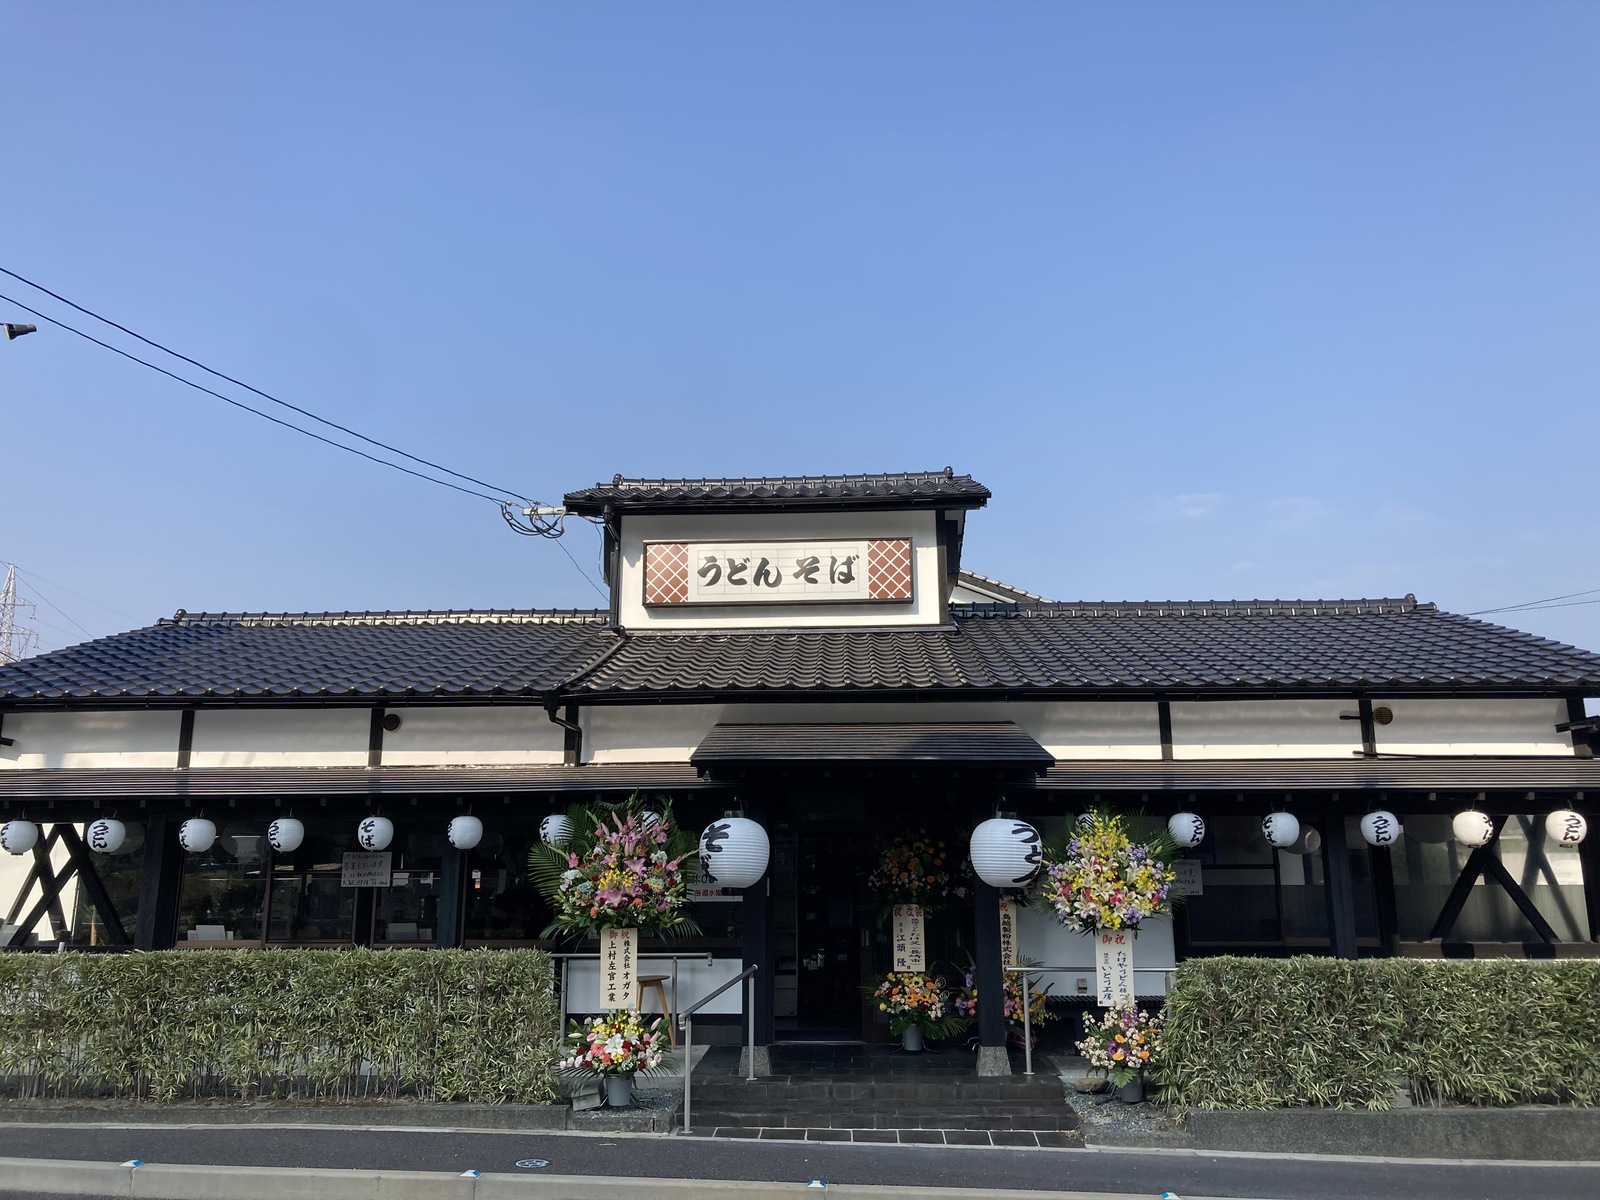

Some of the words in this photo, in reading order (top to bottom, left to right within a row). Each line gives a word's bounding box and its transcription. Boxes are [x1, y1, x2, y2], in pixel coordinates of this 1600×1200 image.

[697, 555, 783, 588] うどん
[792, 554, 860, 585] そば
[92, 822, 109, 849] うどん
[361, 820, 376, 848] そば
[1190, 816, 1205, 844] うどん
[1372, 816, 1392, 843] うどん
[1564, 815, 1583, 842] うどん
[1102, 933, 1126, 945] 御祝
[607, 940, 617, 1003] 上村左官工業
